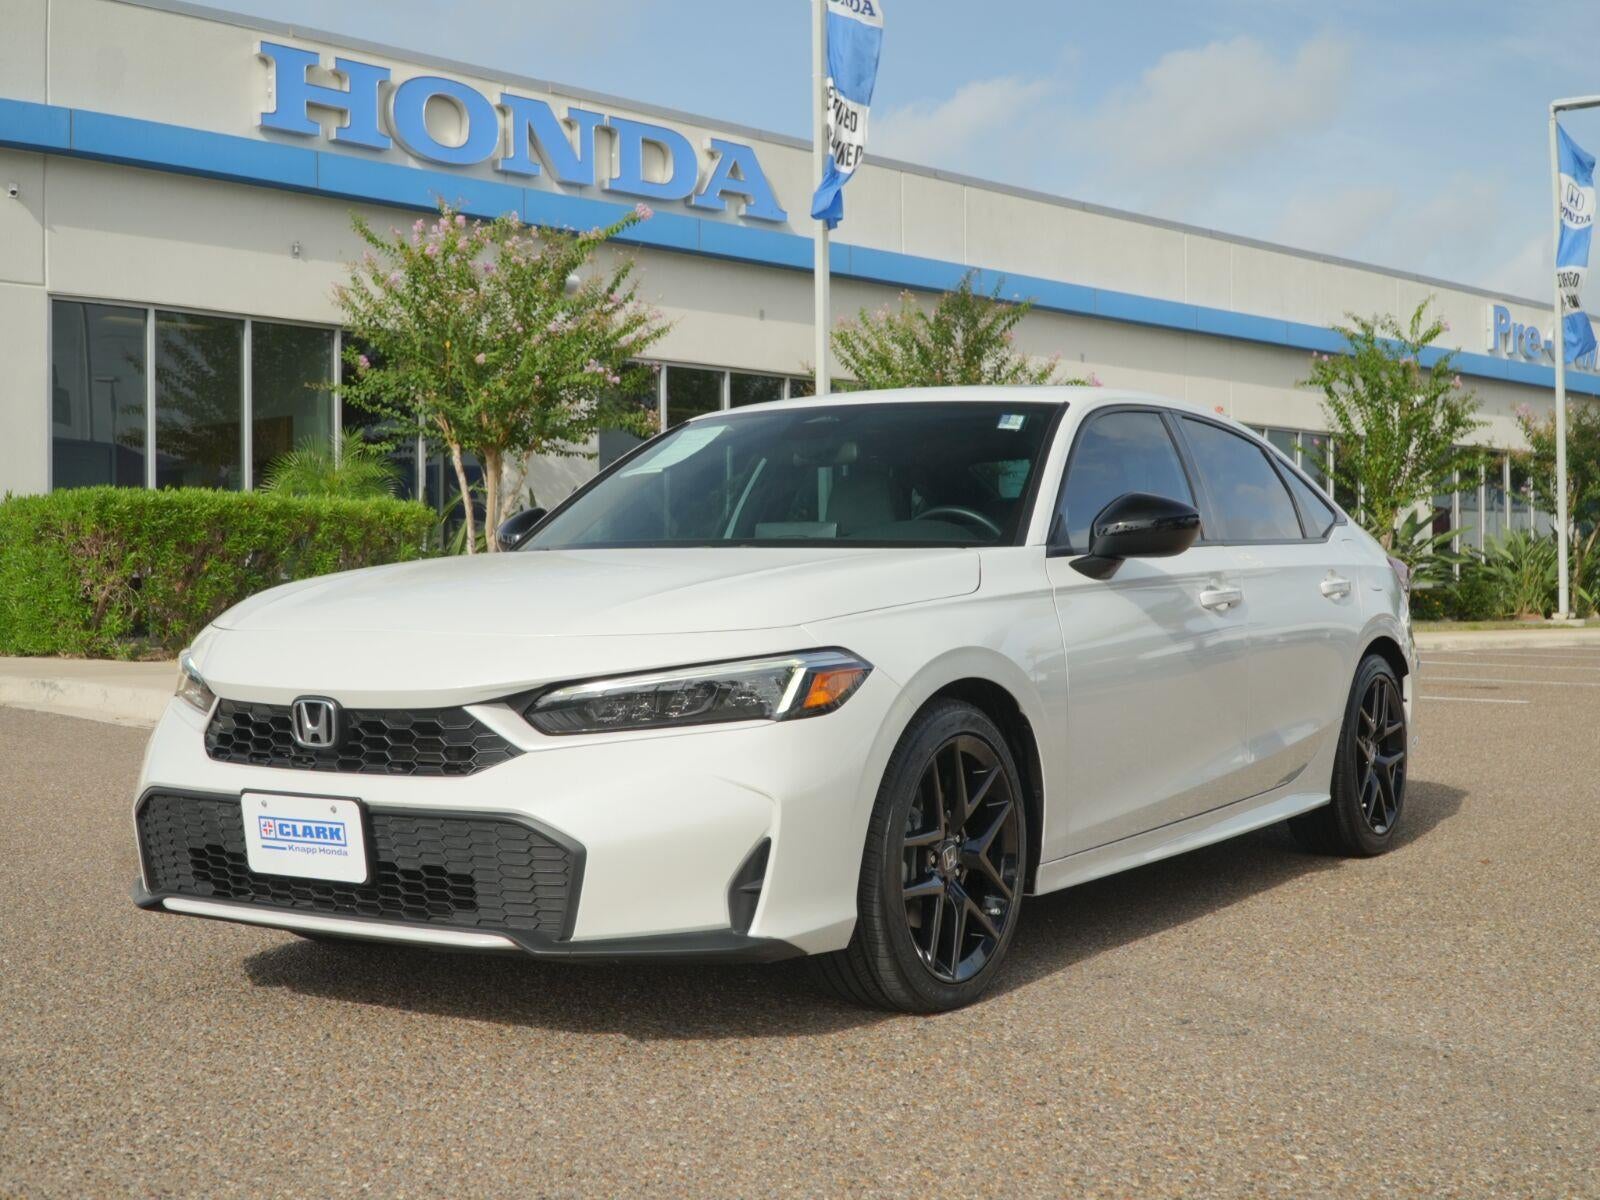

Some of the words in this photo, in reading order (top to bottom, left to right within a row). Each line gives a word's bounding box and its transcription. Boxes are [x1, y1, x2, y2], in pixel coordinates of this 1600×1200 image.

[258, 40, 787, 222] HONDA
[278, 823, 342, 841] CLARK
[288, 845, 317, 854] Knapp
[319, 847, 348, 857] Honda
